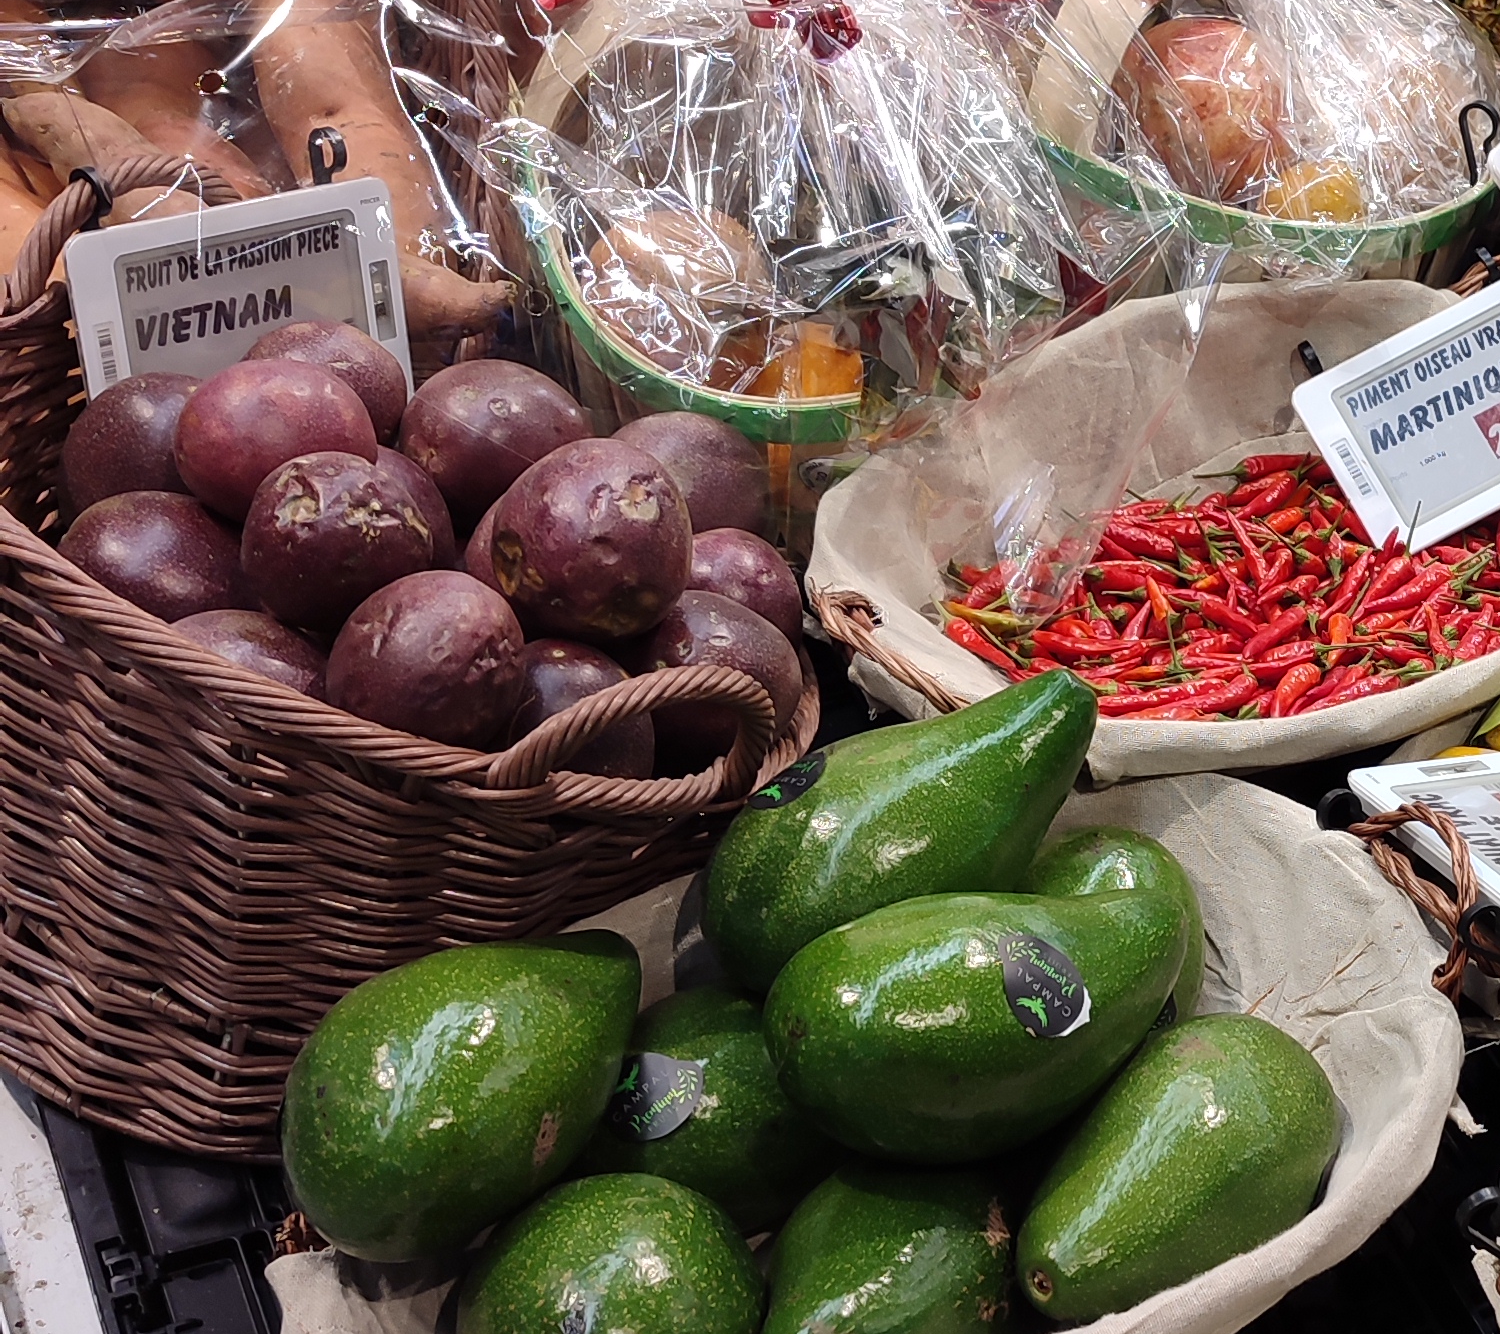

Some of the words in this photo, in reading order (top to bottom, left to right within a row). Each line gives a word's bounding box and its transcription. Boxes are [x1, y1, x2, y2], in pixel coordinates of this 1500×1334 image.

[125, 263, 172, 294] FRUIT
[177, 255, 199, 282] DE
[204, 251, 223, 277] LA
[227, 230, 292, 273] PASSION
[296, 224, 340, 257] PIECE
[134, 284, 293, 352] VIETNAM
[1346, 369, 1410, 418] PIMENT
[1415, 336, 1472, 382] OISEAU
[1017, 967, 1071, 1018] CAMPAL
[1028, 950, 1077, 999] Premium
[612, 1070, 670, 1123] CAMPAL
[629, 1087, 680, 1133] Premium
